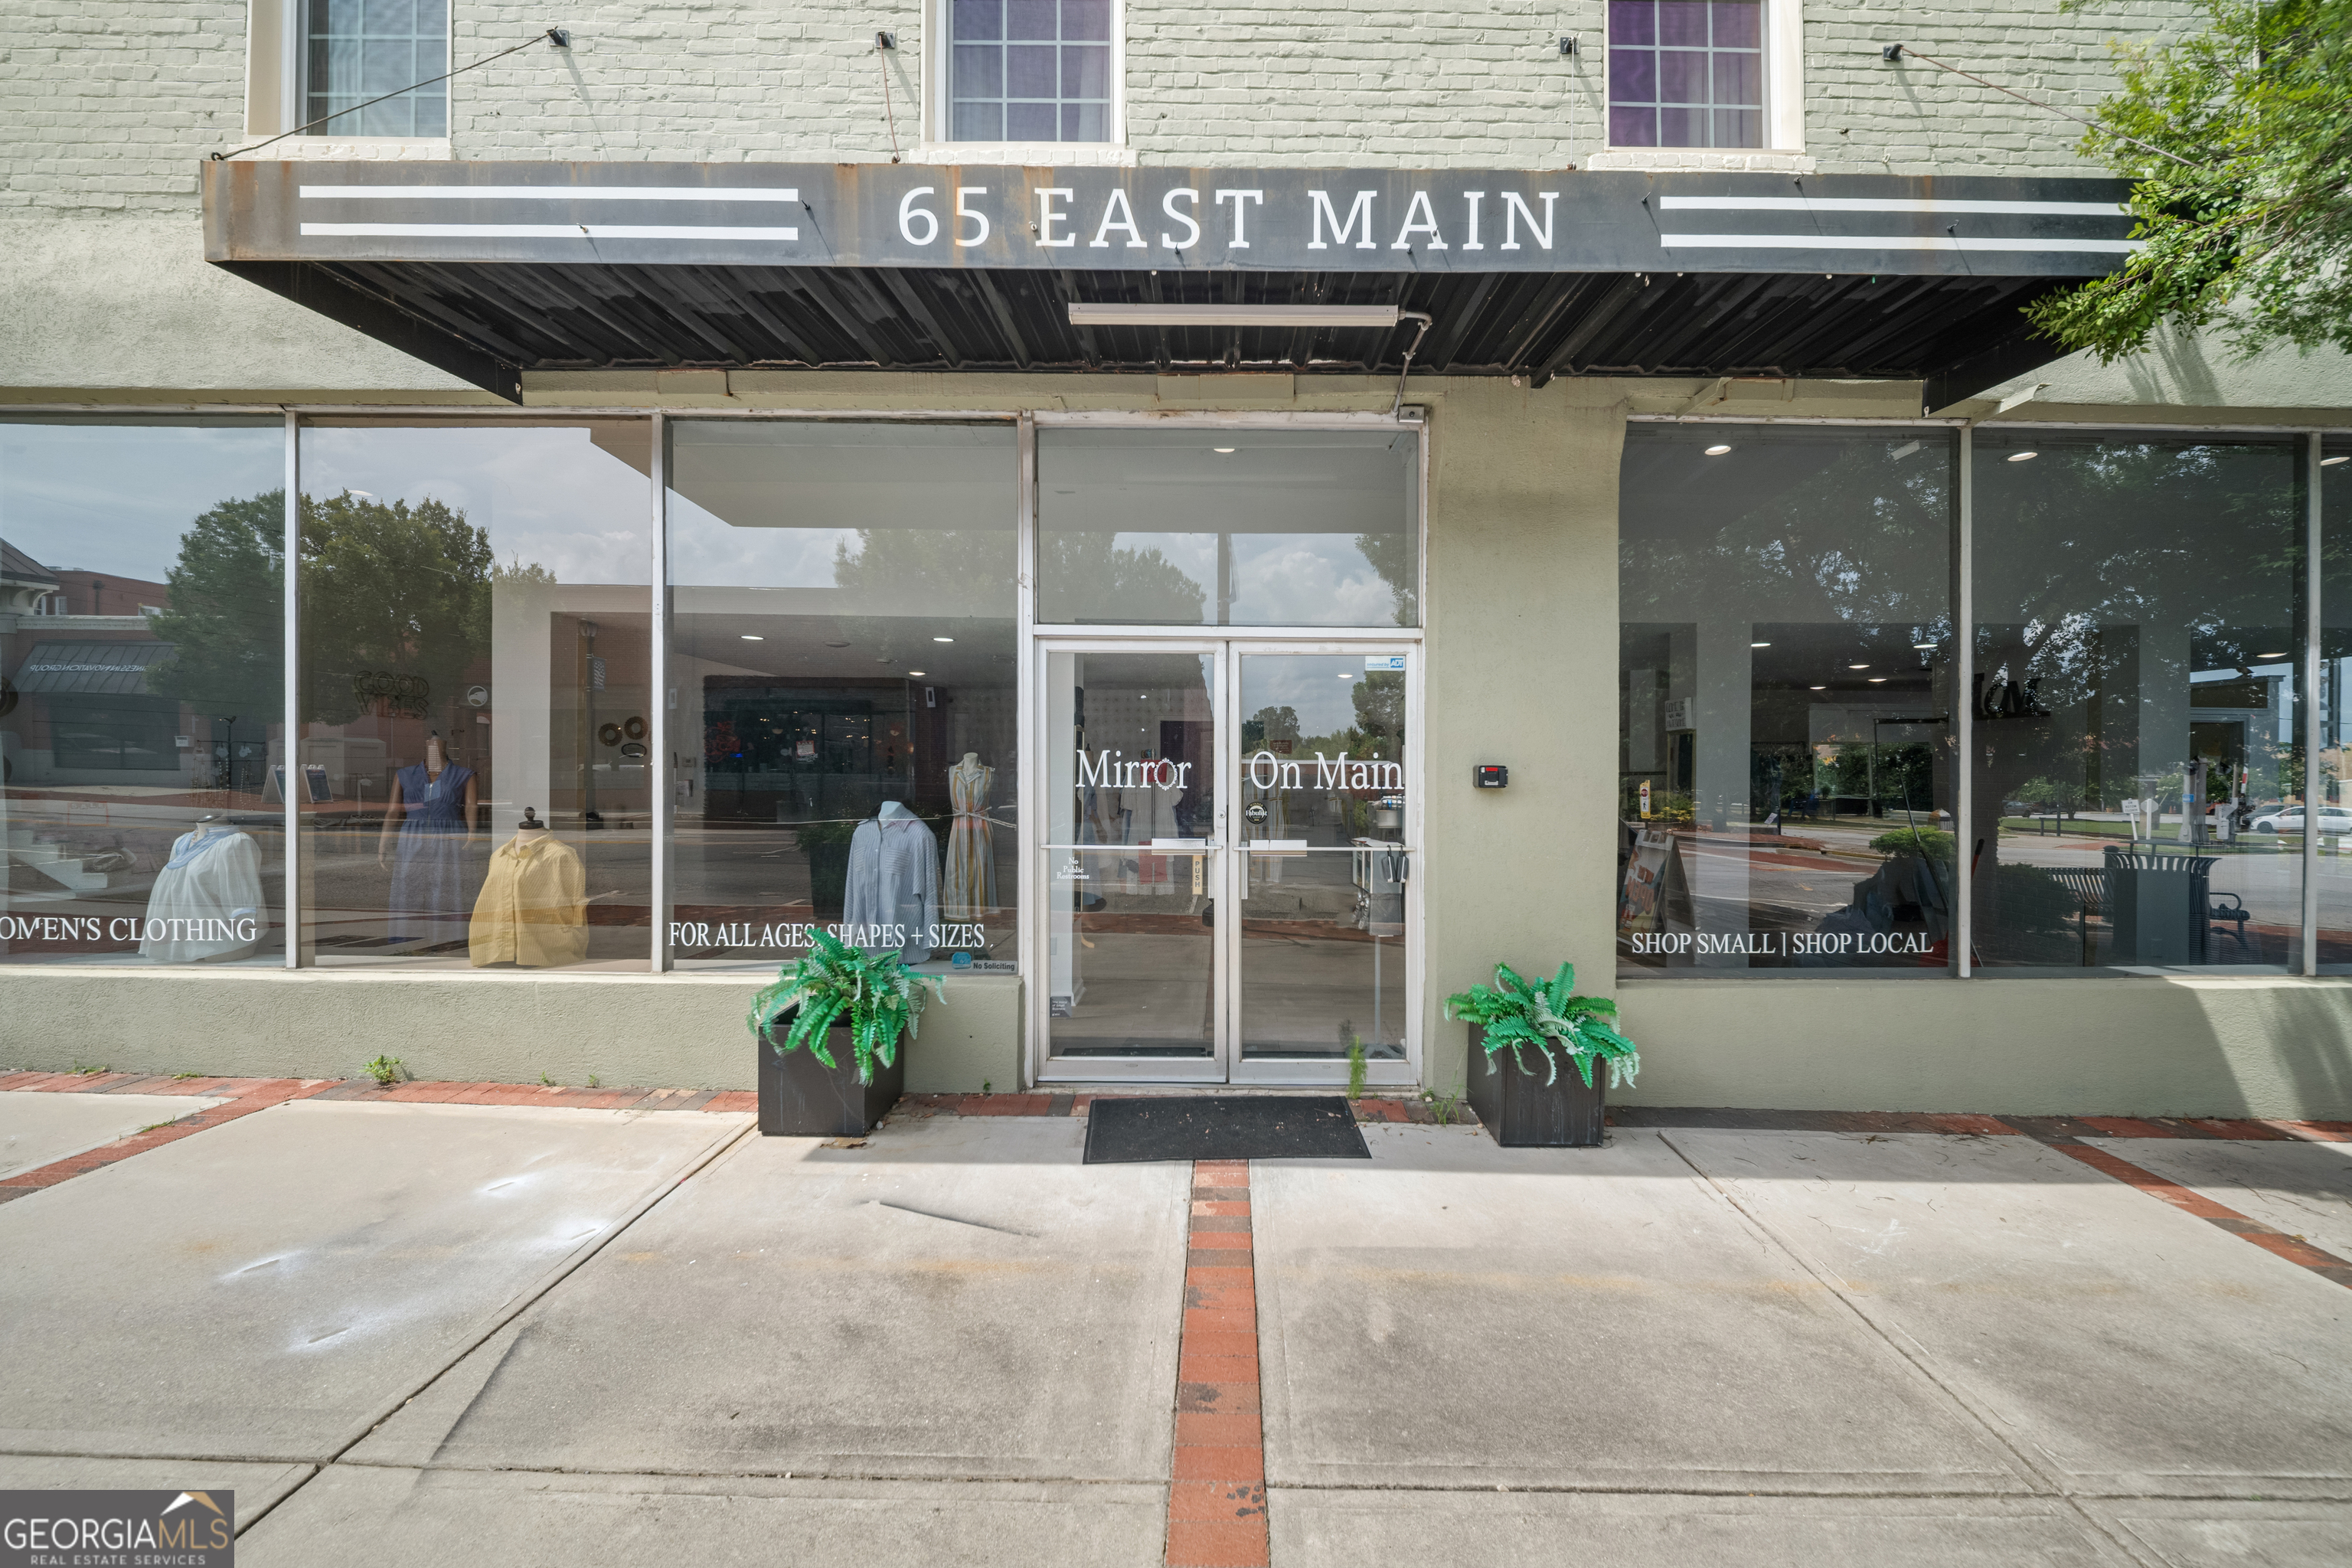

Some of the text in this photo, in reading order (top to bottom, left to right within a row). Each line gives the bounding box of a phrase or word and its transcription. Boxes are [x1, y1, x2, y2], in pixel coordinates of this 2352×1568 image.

[899, 186, 1560, 250] 65 EAST MAIN
[354, 670, 429, 698] GOOD
[354, 691, 429, 720] VIBES
[1075, 749, 1404, 791] Mirror On Main
[1057, 871, 1089, 880] Restrooms
[109, 917, 257, 941] CLOTHING
[668, 922, 711, 946] FOR
[714, 922, 756, 947] ALL
[911, 926, 923, 945] +
[1632, 933, 1692, 954] SHOP
[1697, 933, 1776, 954] SMALL
[1792, 933, 1851, 954] SHOP
[1857, 932, 1933, 953] LOCAL
[984, 962, 1015, 971] Soliciting
